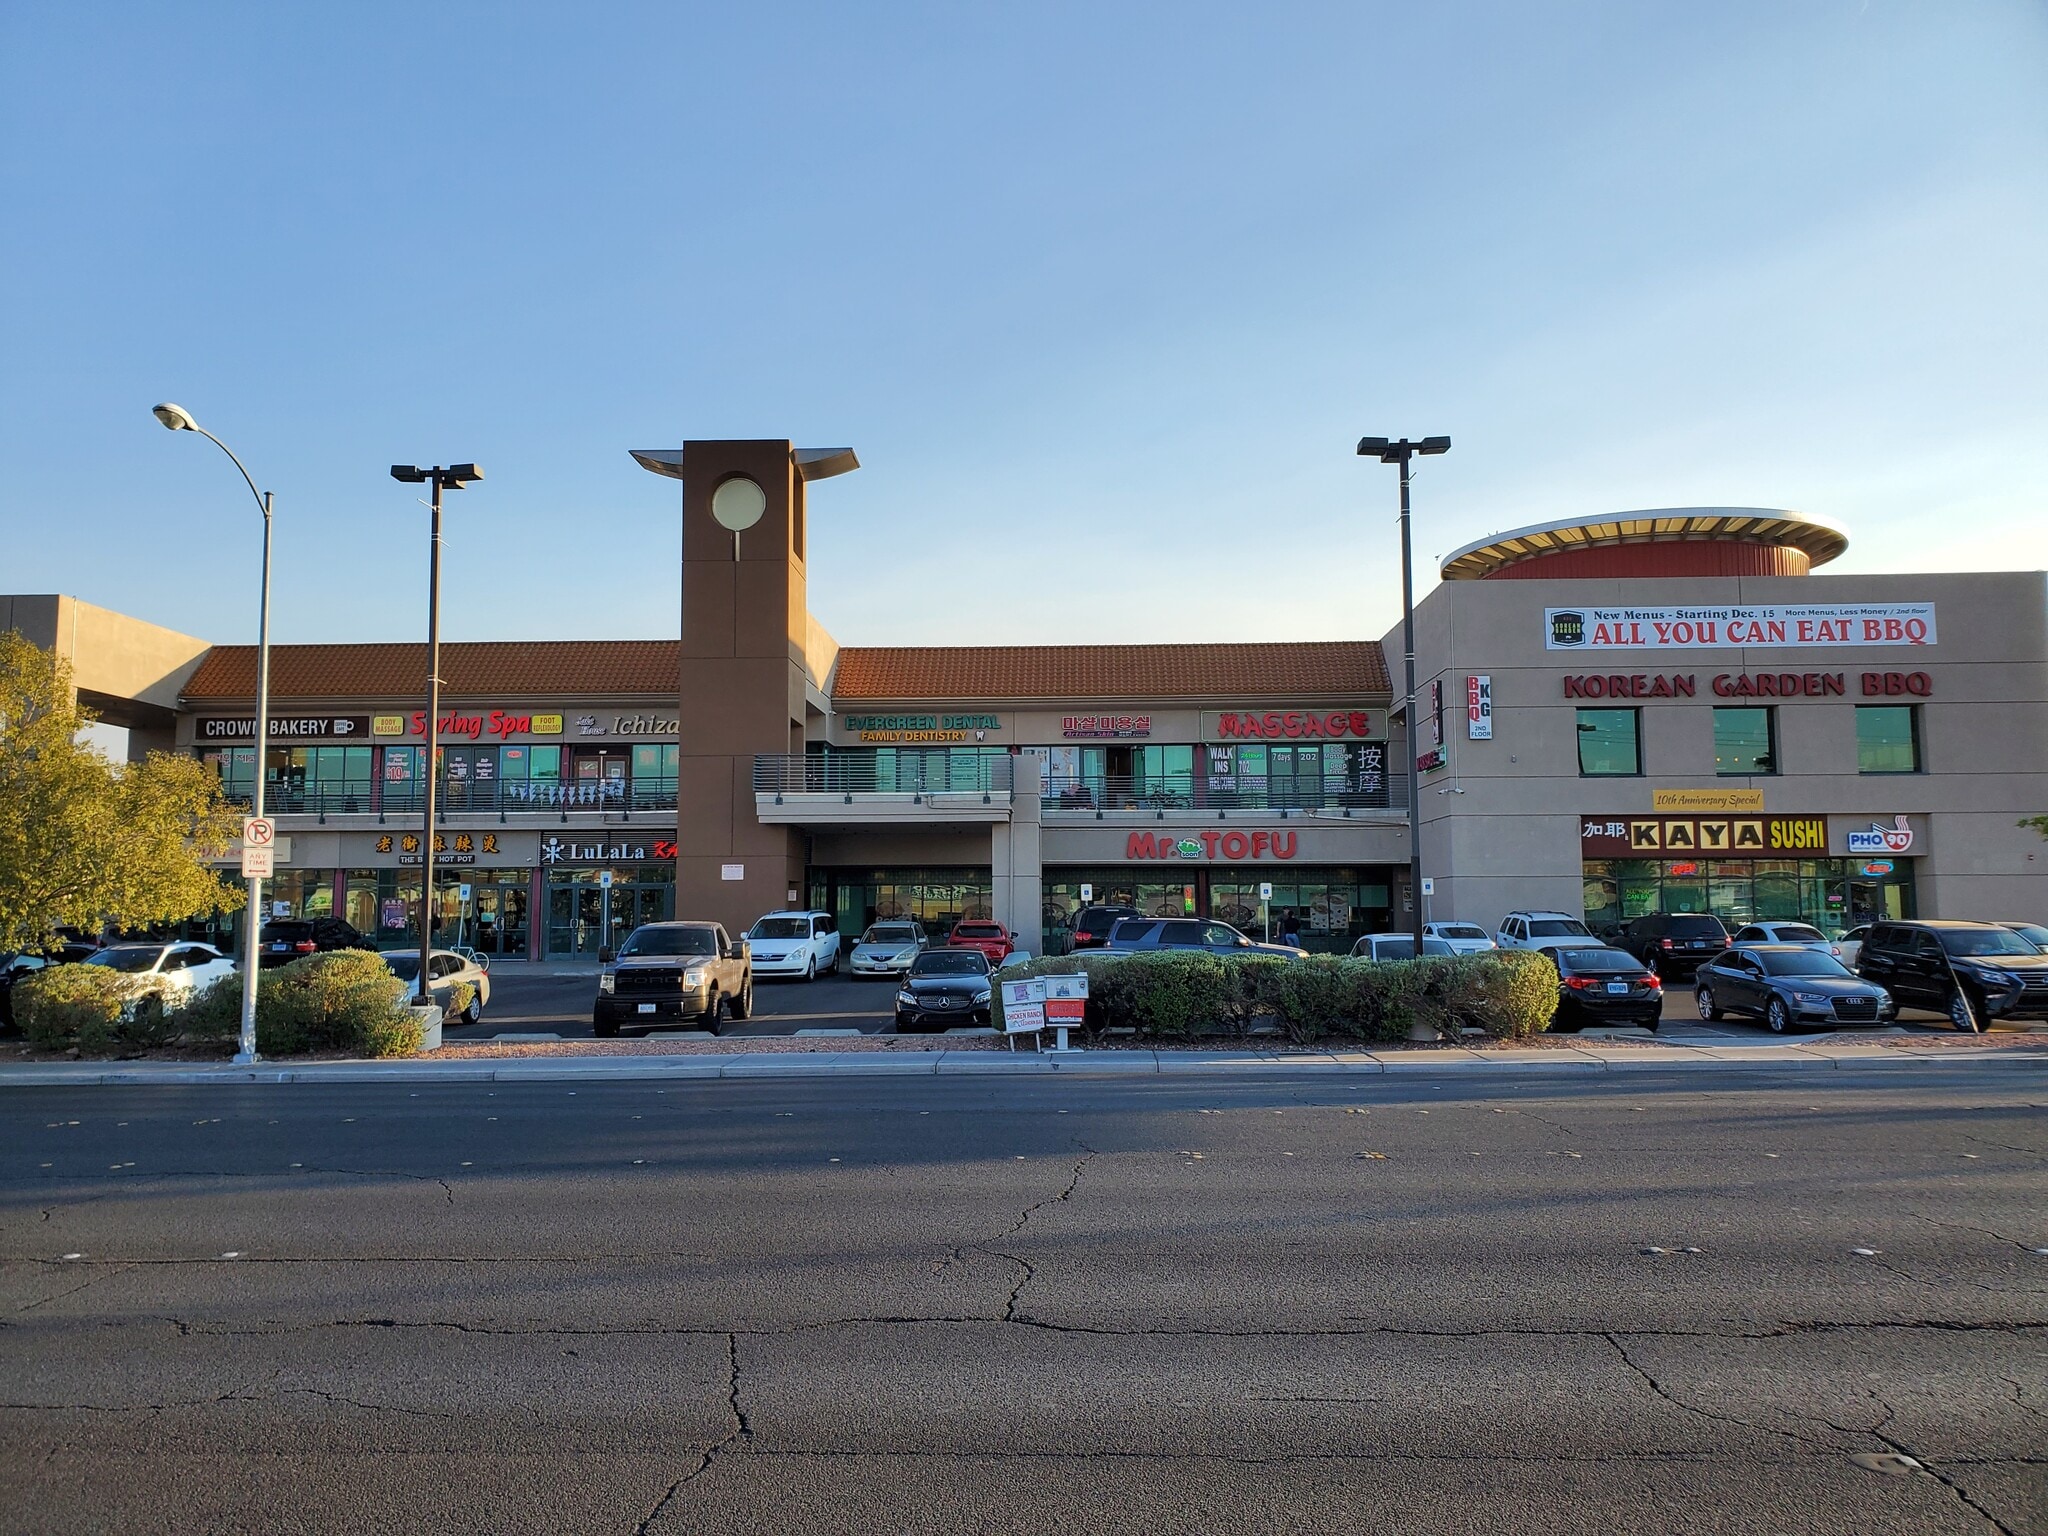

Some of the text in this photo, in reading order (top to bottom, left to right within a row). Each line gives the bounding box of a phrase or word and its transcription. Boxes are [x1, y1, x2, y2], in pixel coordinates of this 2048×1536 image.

[1593, 611, 1619, 620] New
[1623, 610, 1665, 620] Menus
[1675, 609, 1728, 620] Starting
[1731, 609, 1758, 618] Dec.
[1762, 609, 1775, 618] 15
[1808, 609, 1838, 617] Menus,
[1839, 608, 1858, 616] Less
[1860, 608, 1888, 617] Money
[1591, 618, 1928, 646] ALL YOU CAN EAT BBQ
[1563, 671, 1933, 699] KOREAN GARDEN BBQ
[269, 719, 328, 735] BAKERY
[375, 725, 402, 733] MASSAGE
[410, 710, 531, 740] Sring Spa
[610, 714, 680, 735] Ichiza
[845, 714, 1002, 731] EVERGREEN DENTAL
[1099, 715, 1151, 731] 미용실
[1218, 710, 1371, 738] MASSAGE
[861, 730, 967, 742] FAMILY DENTISTRY
[1209, 747, 1233, 760] WALK
[1277, 753, 1291, 763] days
[1300, 753, 1317, 761] 202
[1324, 753, 1353, 761] Massage
[1214, 760, 1229, 773] INS
[1238, 760, 1250, 773] 702
[1330, 762, 1348, 770] Deep
[1358, 745, 1383, 793] 按摩
[1656, 793, 1761, 808] 10th Anniversary Special
[1582, 821, 1626, 838] 加耶
[1631, 820, 1825, 849] KAYA SUSHI
[1126, 831, 1297, 860] Mr. TOFU
[1850, 834, 1908, 846] PHO 90
[570, 843, 646, 860] LuLaLa
[439, 855, 454, 863] HOT
[1671, 862, 1697, 875] OPEN
[616, 976, 682, 984] FORD
[1006, 1012, 1027, 1020] CHICKEN
